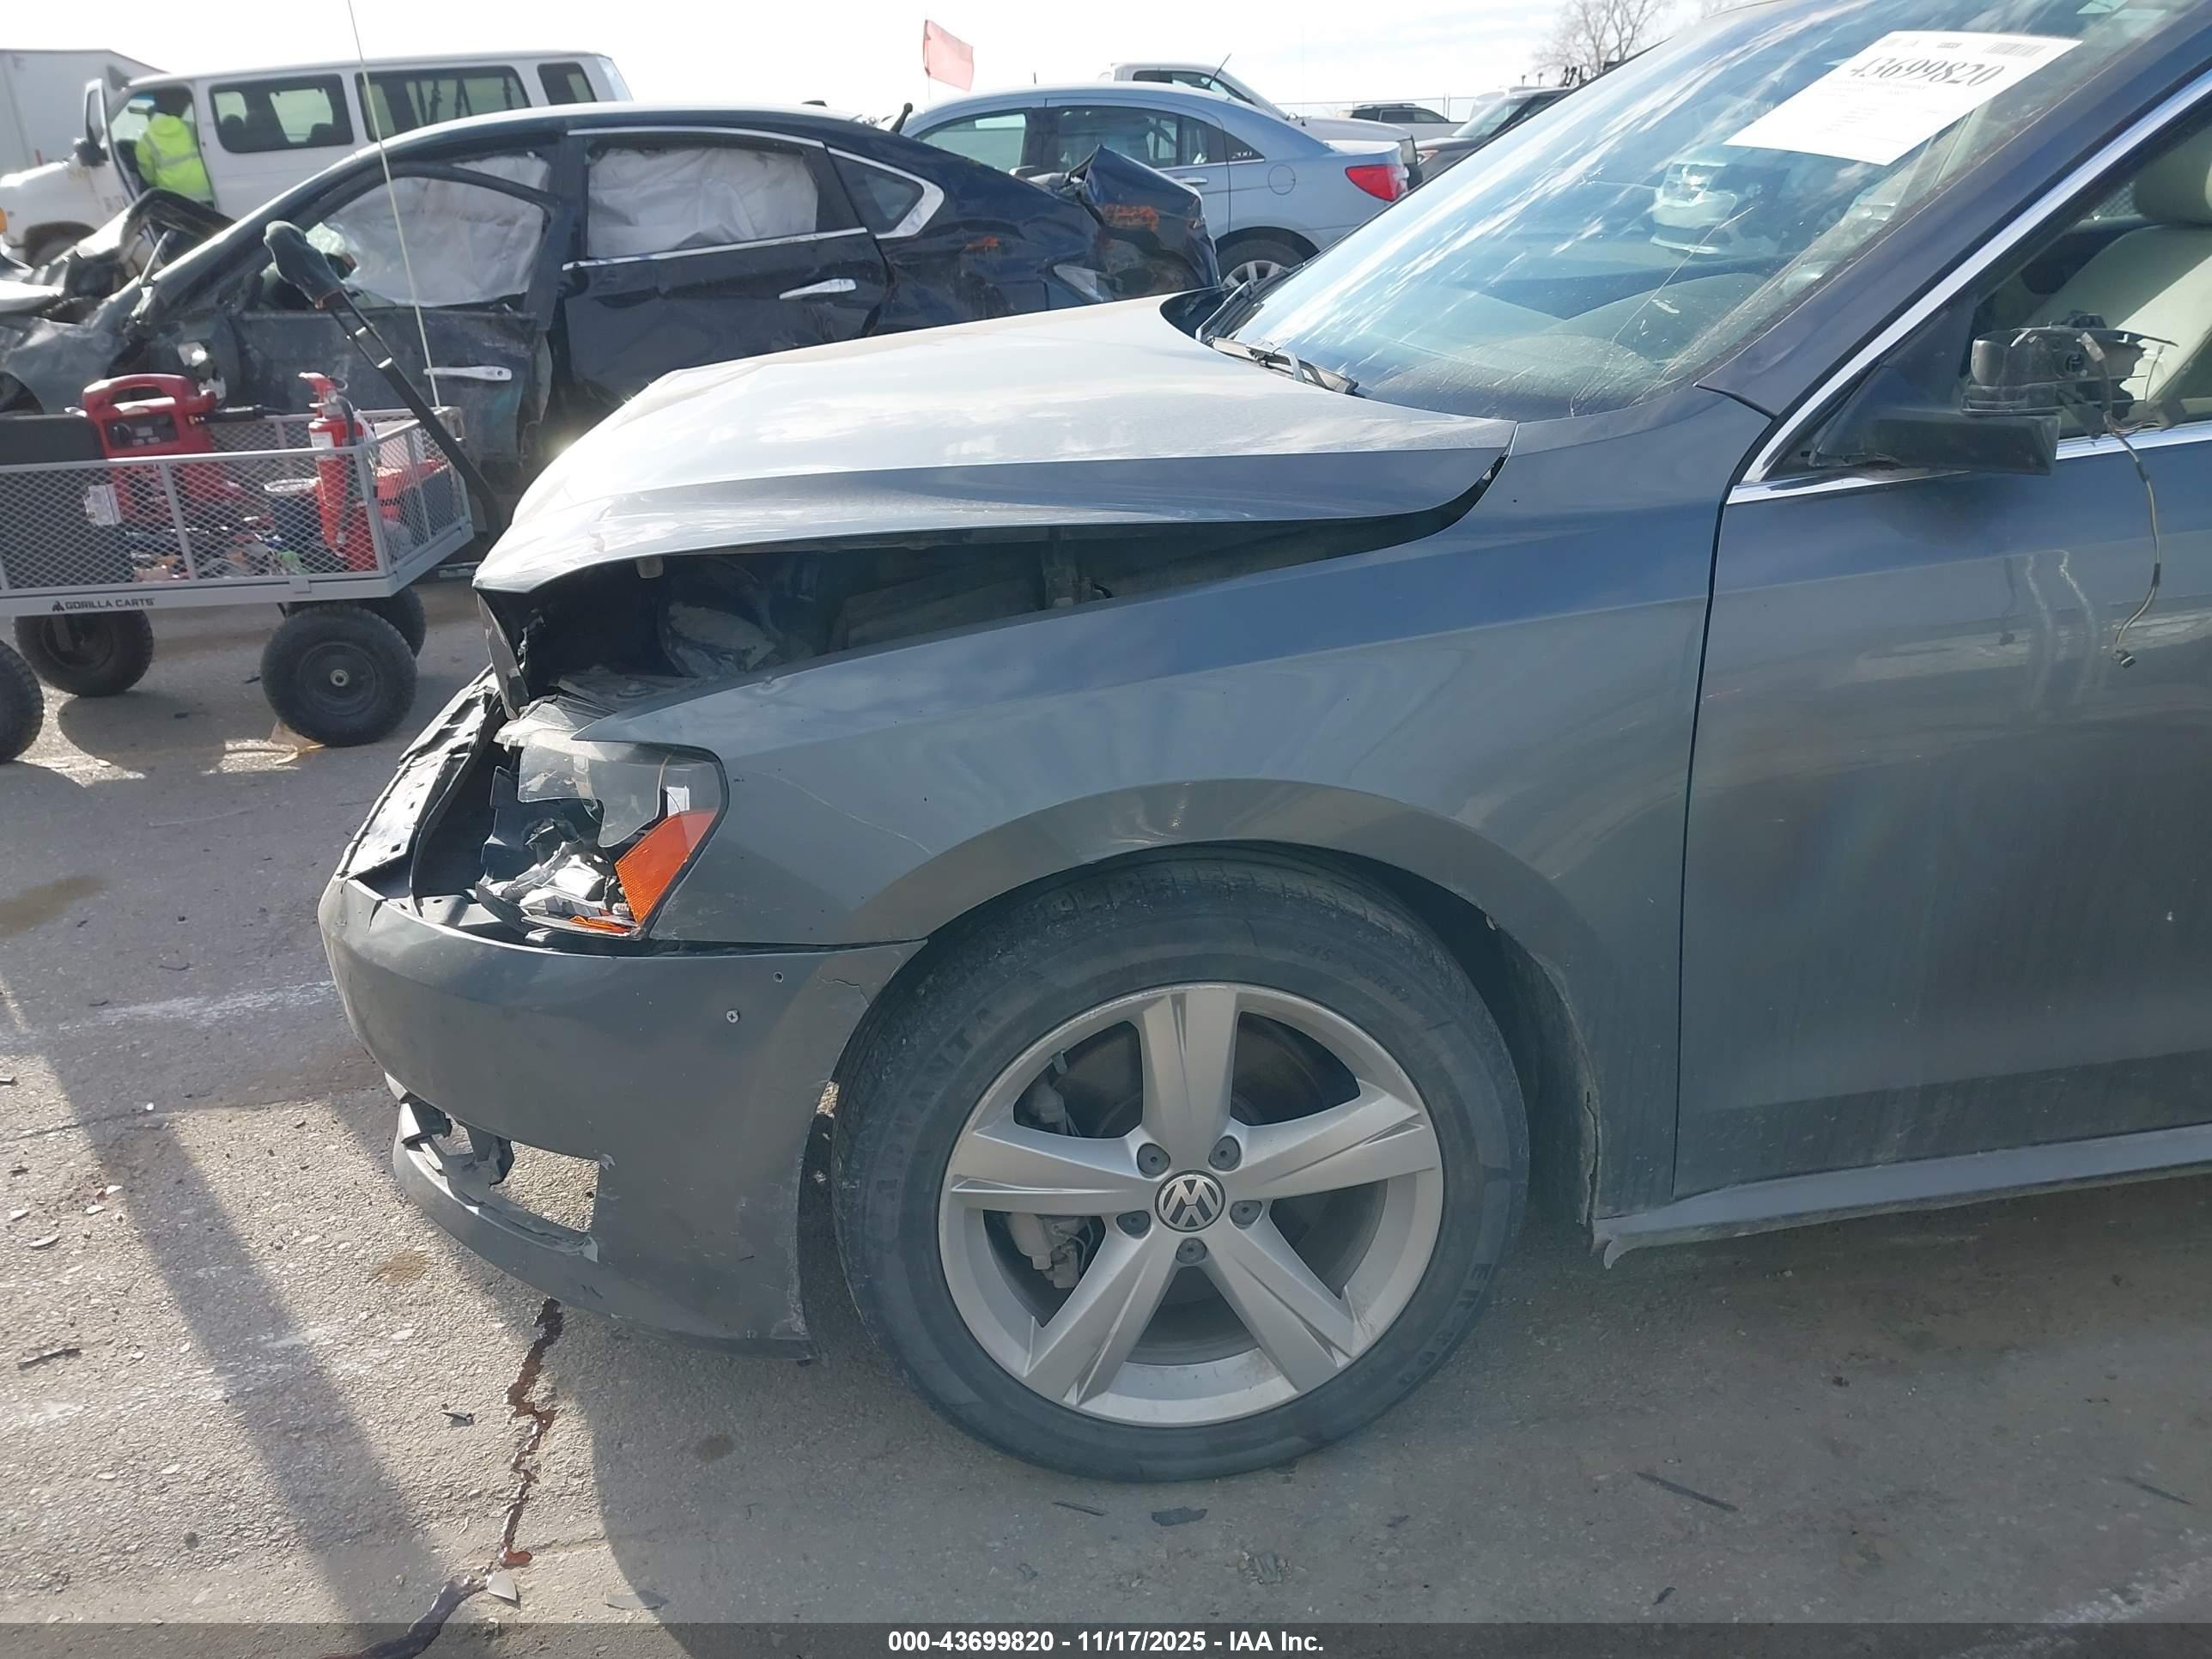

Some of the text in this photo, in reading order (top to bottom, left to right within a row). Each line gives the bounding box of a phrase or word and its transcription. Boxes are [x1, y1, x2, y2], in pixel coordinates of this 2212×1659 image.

[1850, 57, 2005, 87] 43699820
[64, 598, 154, 610] GORILLA CARTS
